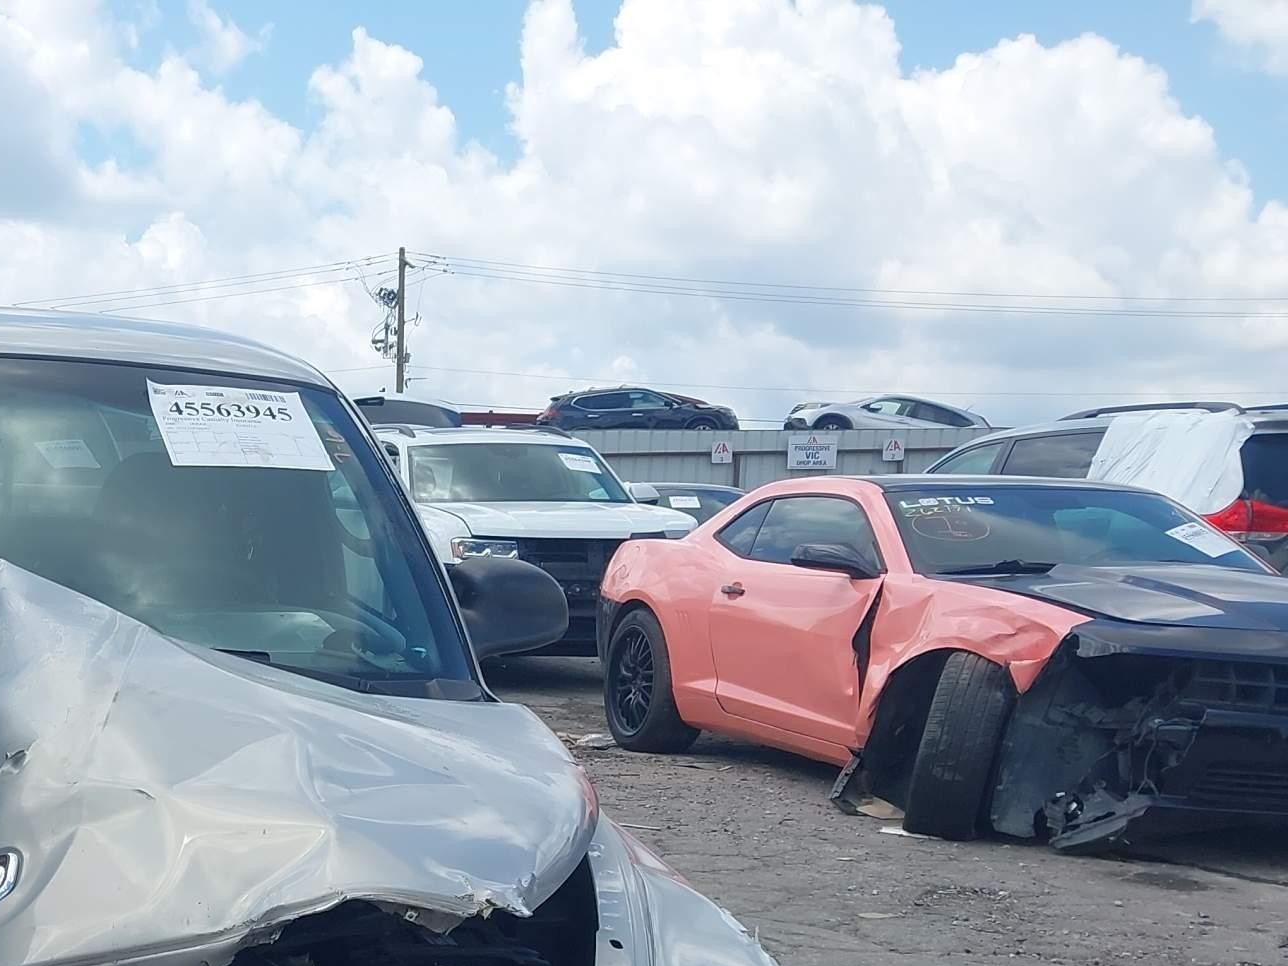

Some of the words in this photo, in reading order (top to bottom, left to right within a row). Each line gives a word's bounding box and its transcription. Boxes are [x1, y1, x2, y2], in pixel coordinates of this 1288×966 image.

[169, 401, 293, 422] 45563945
[805, 451, 820, 460] VIC
[899, 496, 995, 508] LOTUS
